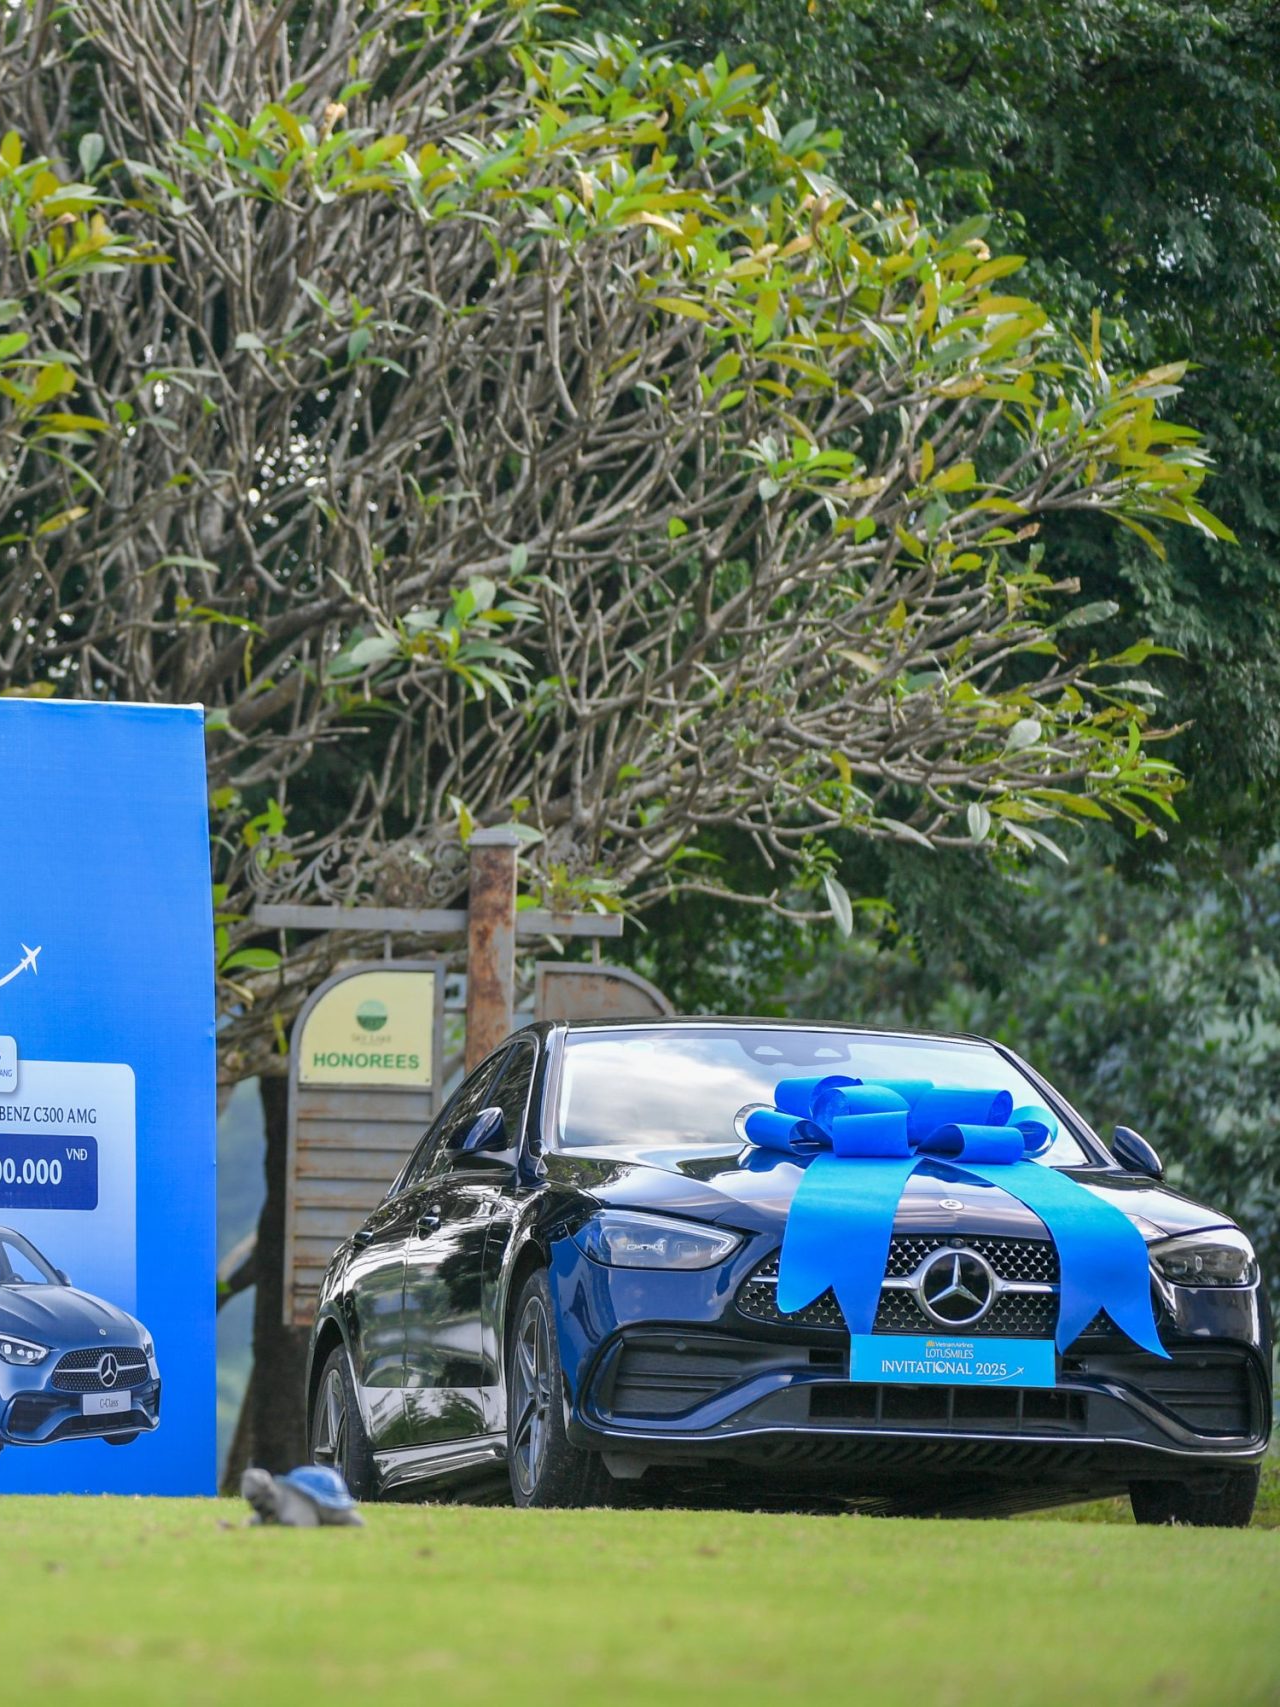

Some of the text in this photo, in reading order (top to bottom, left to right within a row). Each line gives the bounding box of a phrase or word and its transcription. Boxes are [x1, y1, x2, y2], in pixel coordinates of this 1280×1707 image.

[313, 1052, 420, 1070] HONOREES
[33, 1106, 64, 1124] C300
[67, 1107, 97, 1124] AMG
[66, 1148, 88, 1161] VNĐ
[881, 1360, 1007, 1376] INVITATIONAL 2025
